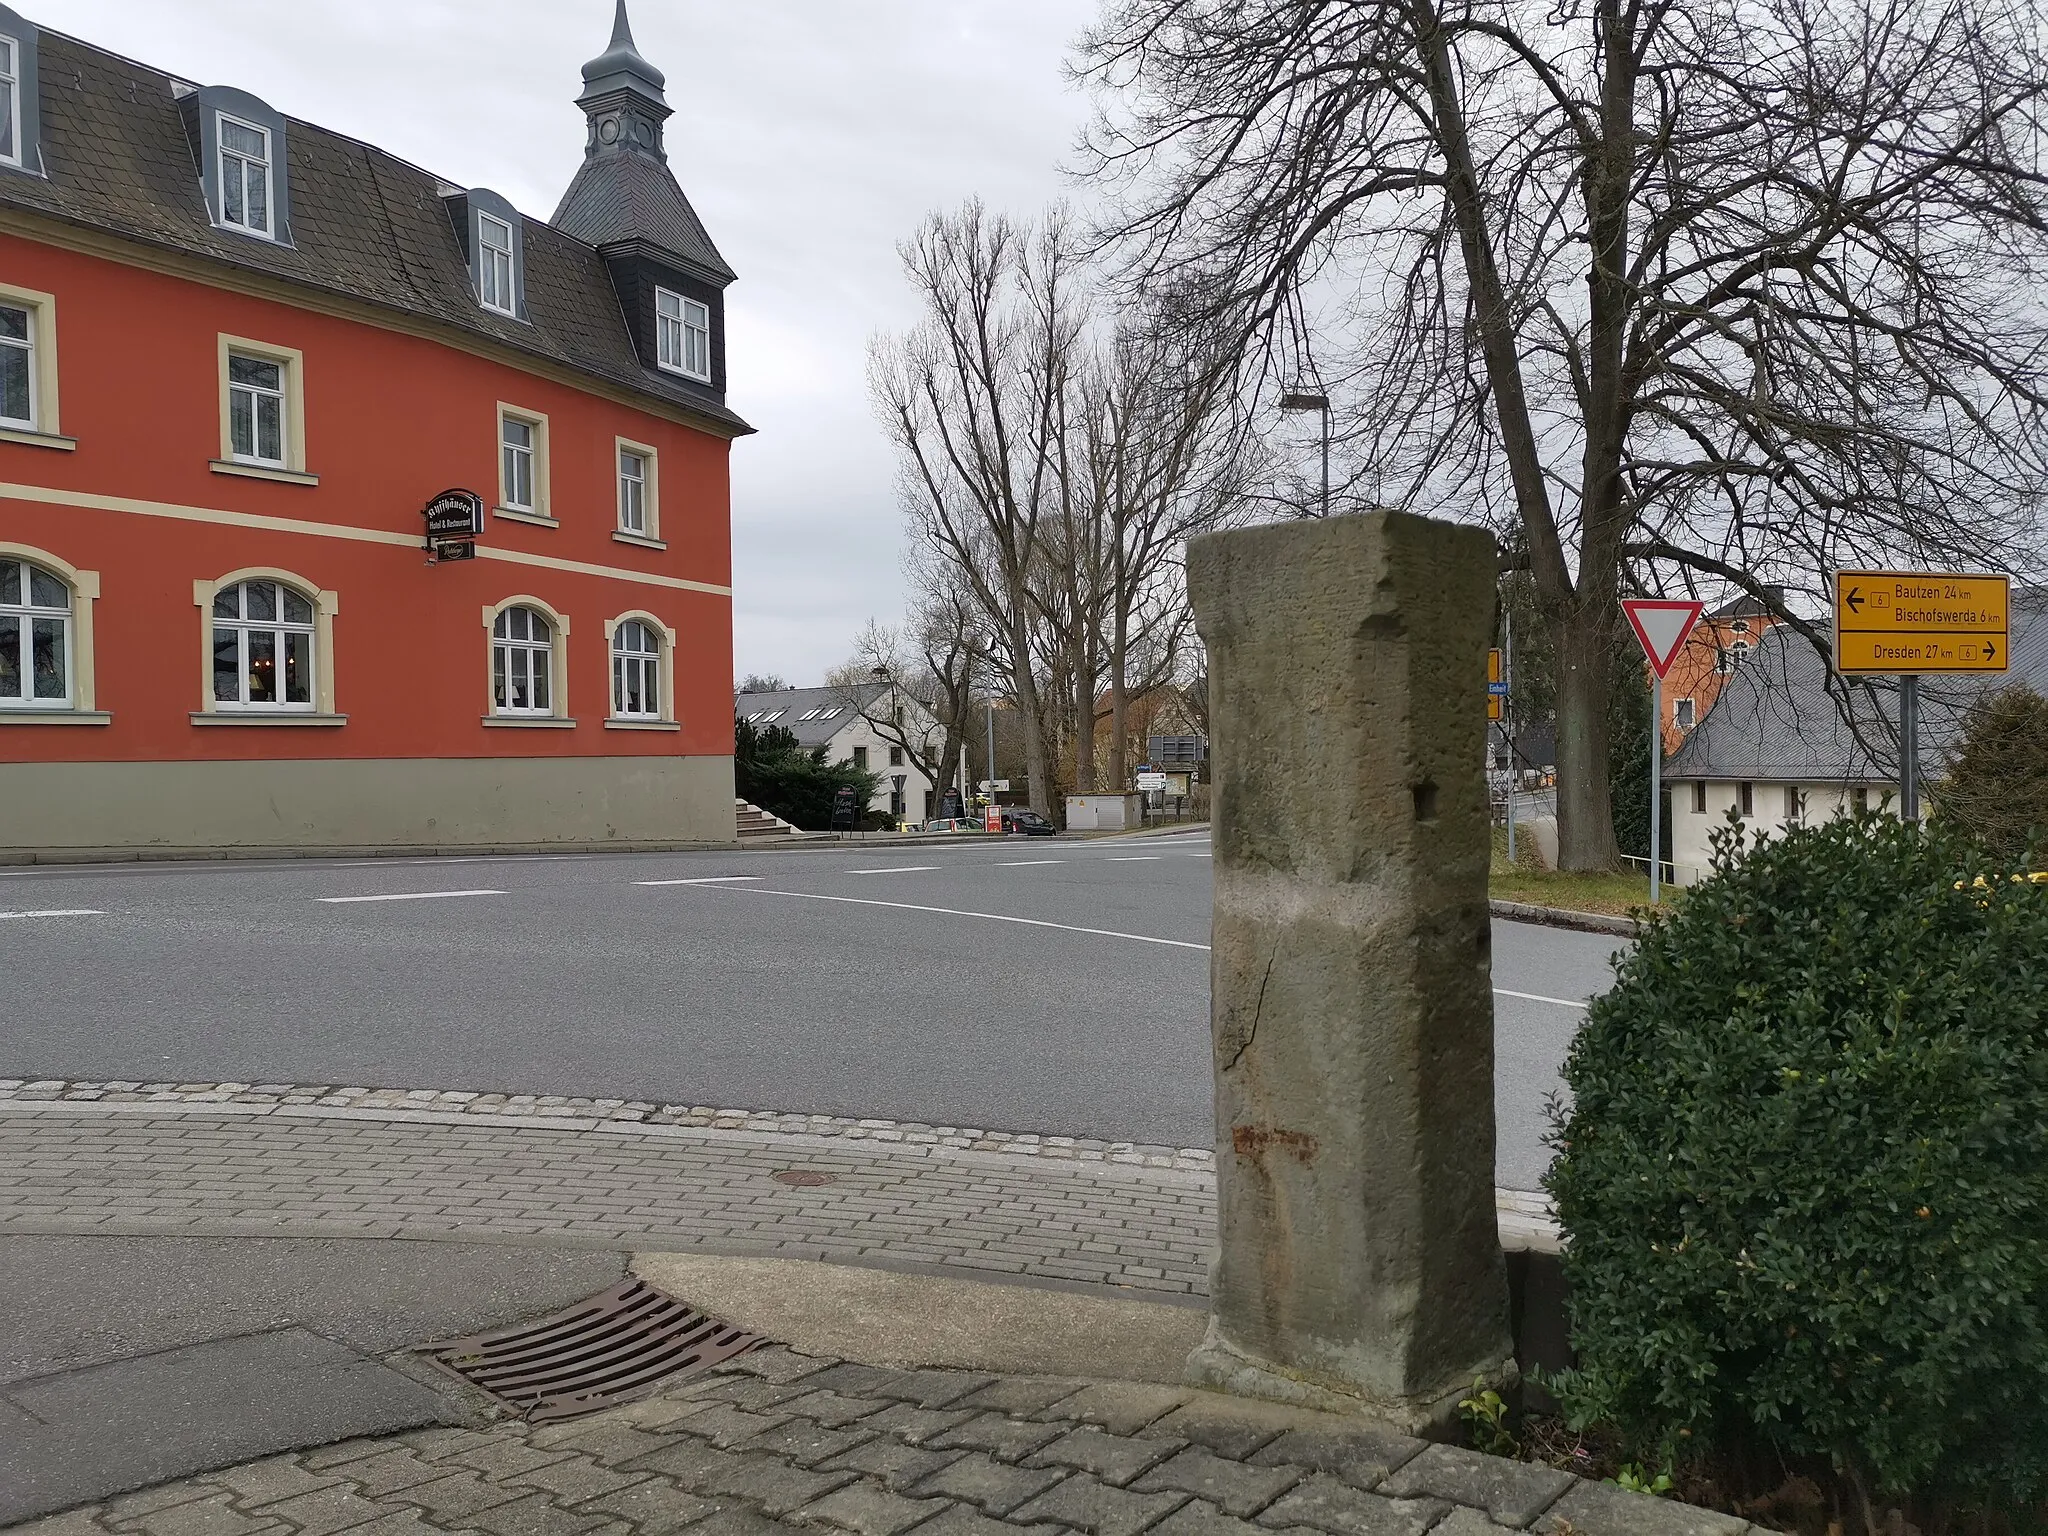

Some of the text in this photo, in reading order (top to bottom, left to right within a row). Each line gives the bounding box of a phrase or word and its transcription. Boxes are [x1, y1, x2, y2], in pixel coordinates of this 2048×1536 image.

[429, 518, 470, 530] Hotel & Restaurant
[1895, 584, 1971, 599] Bautzen 24 km
[1877, 595, 1883, 605] 6
[1895, 608, 2000, 623] Bischofswerda 6 km
[1874, 645, 1971, 659] Dresden 27 km 6
